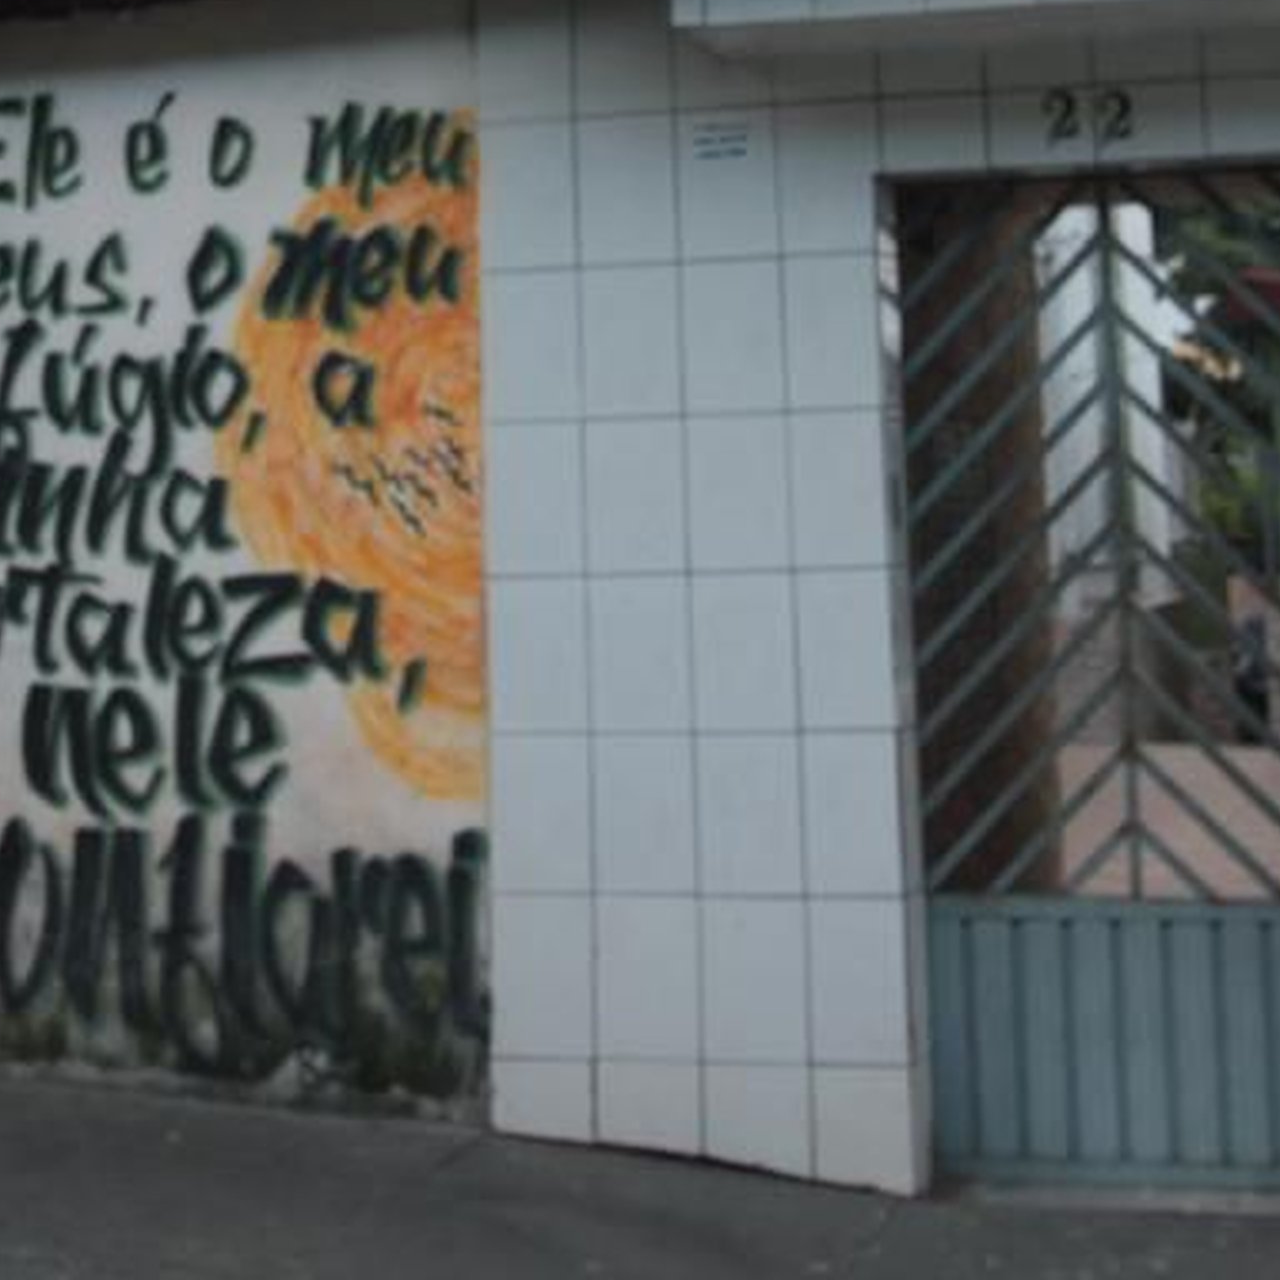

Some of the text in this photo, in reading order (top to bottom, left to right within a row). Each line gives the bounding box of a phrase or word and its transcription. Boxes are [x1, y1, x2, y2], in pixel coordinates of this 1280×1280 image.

[125, 92, 177, 196] é
[209, 116, 256, 188] o
[302, 100, 476, 210] meu
[1042, 86, 1134, 142] 22
[186, 225, 243, 317] o
[260, 217, 466, 330] meu
[311, 348, 377, 428] a
[22, 670, 290, 820] nele
